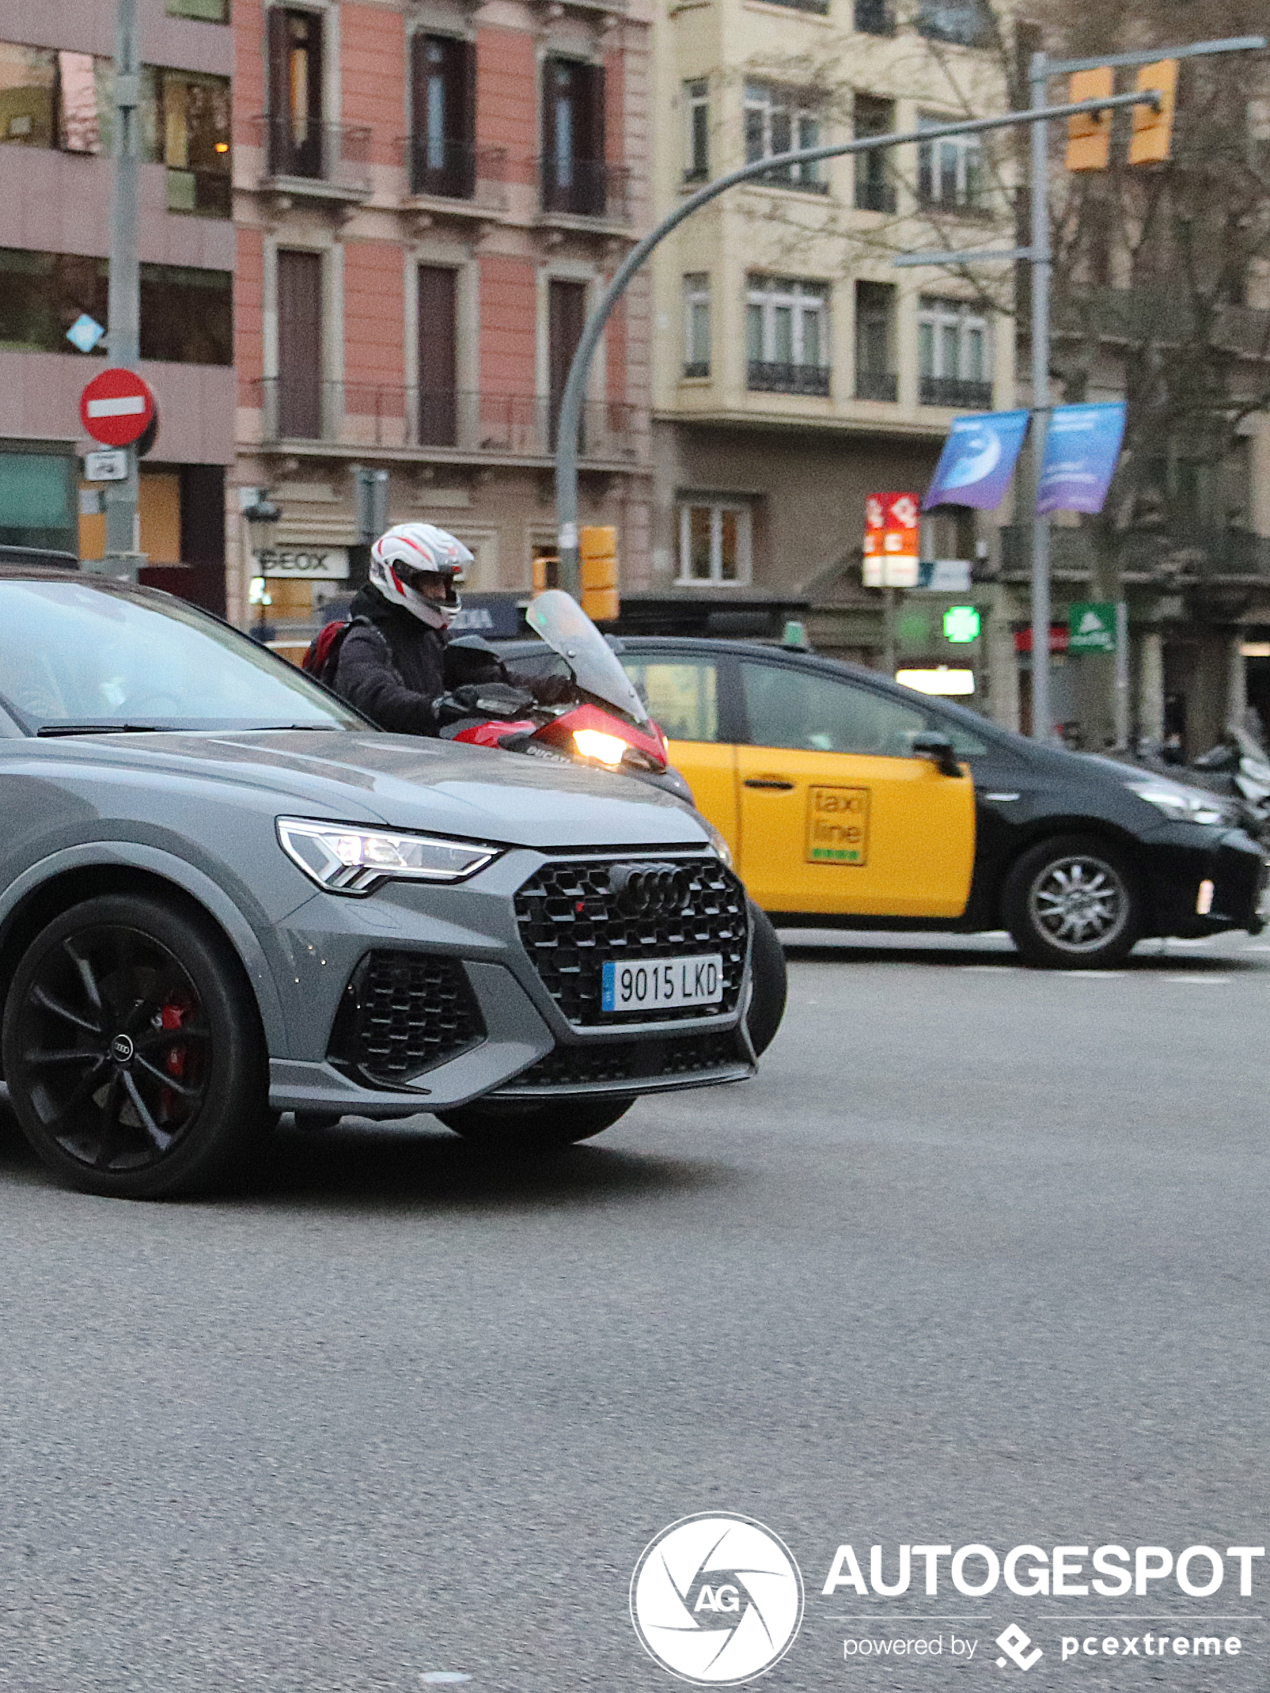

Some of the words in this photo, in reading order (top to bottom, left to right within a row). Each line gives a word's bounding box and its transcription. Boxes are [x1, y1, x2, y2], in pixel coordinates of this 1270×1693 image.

[260, 550, 328, 571] GEOX
[814, 789, 864, 813] taxi
[813, 819, 862, 843] line
[620, 966, 675, 1002] 9015
[682, 963, 718, 998] LKD
